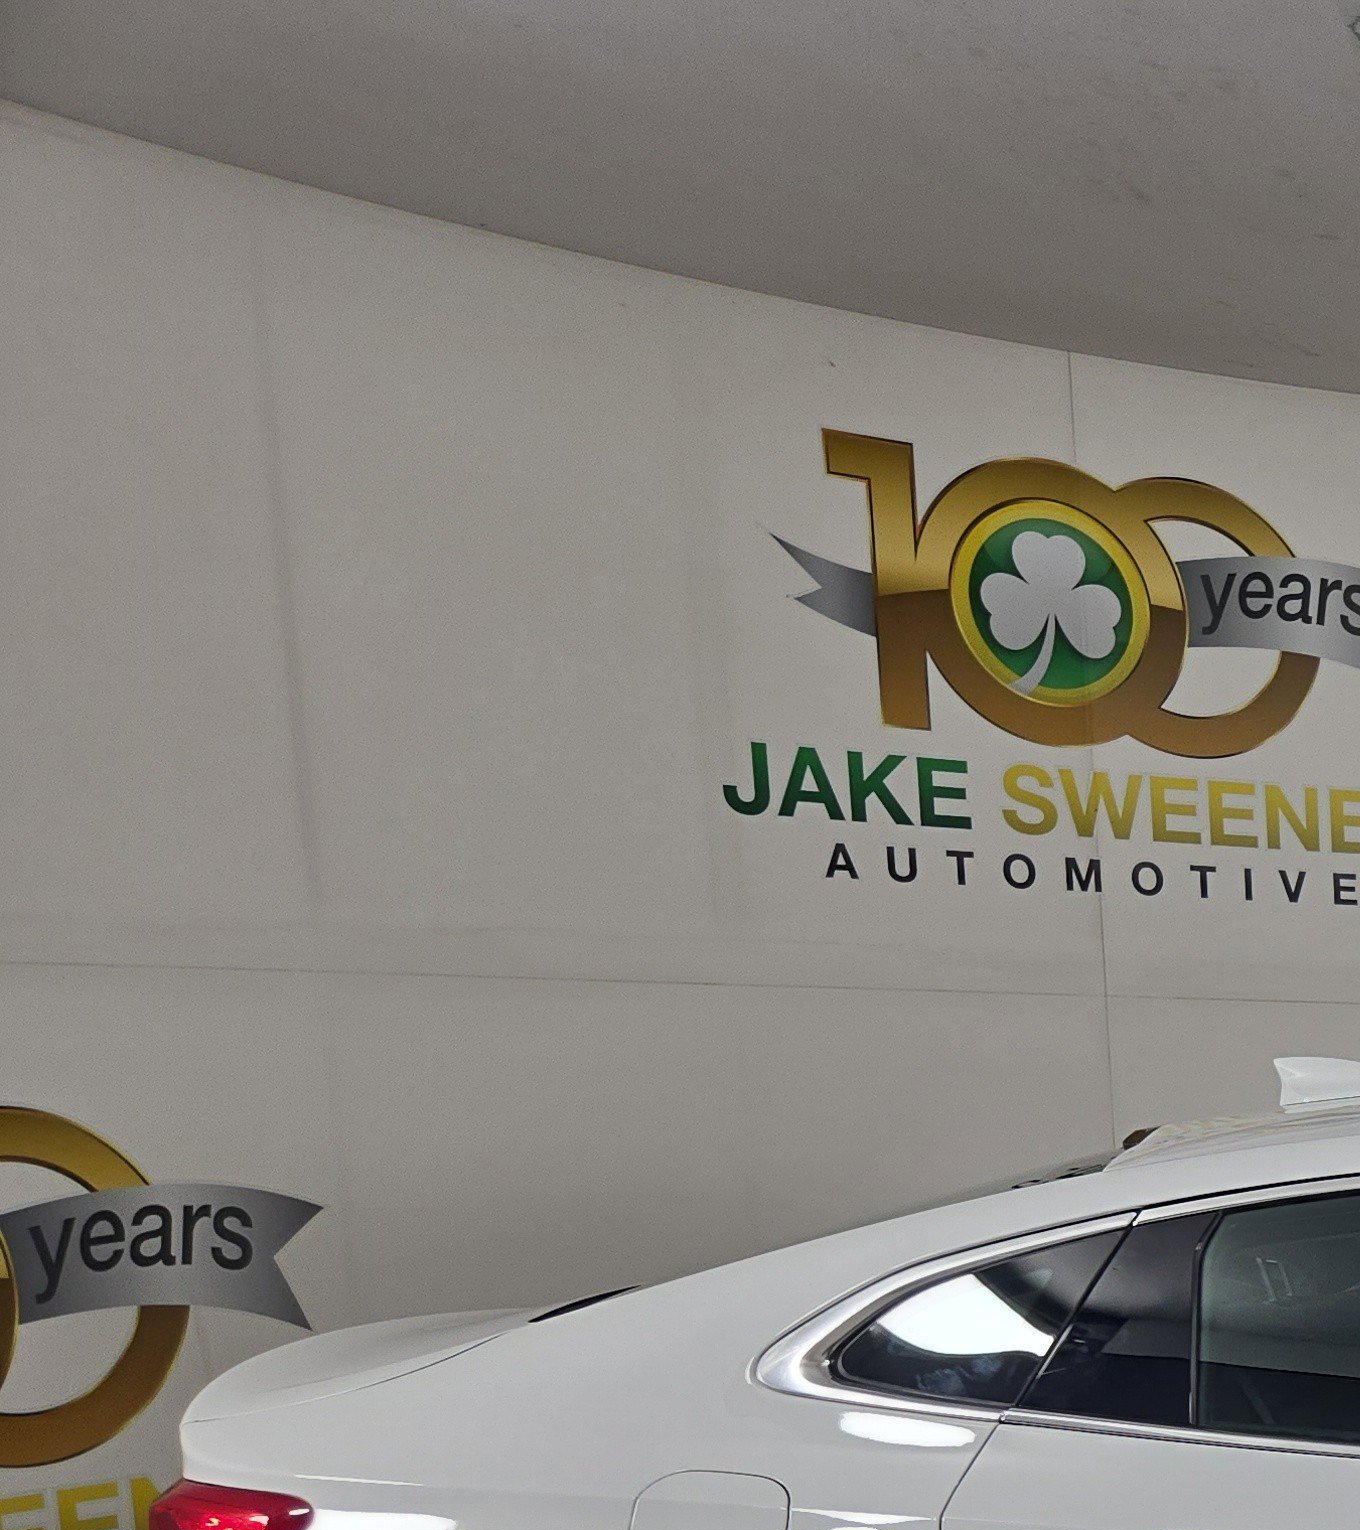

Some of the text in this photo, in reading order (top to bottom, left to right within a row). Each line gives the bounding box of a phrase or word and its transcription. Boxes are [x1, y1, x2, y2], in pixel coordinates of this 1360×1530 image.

[722, 741, 973, 830] JAKE
[825, 842, 1359, 906] AUTOMOTIVE
[28, 1204, 254, 1302] years
